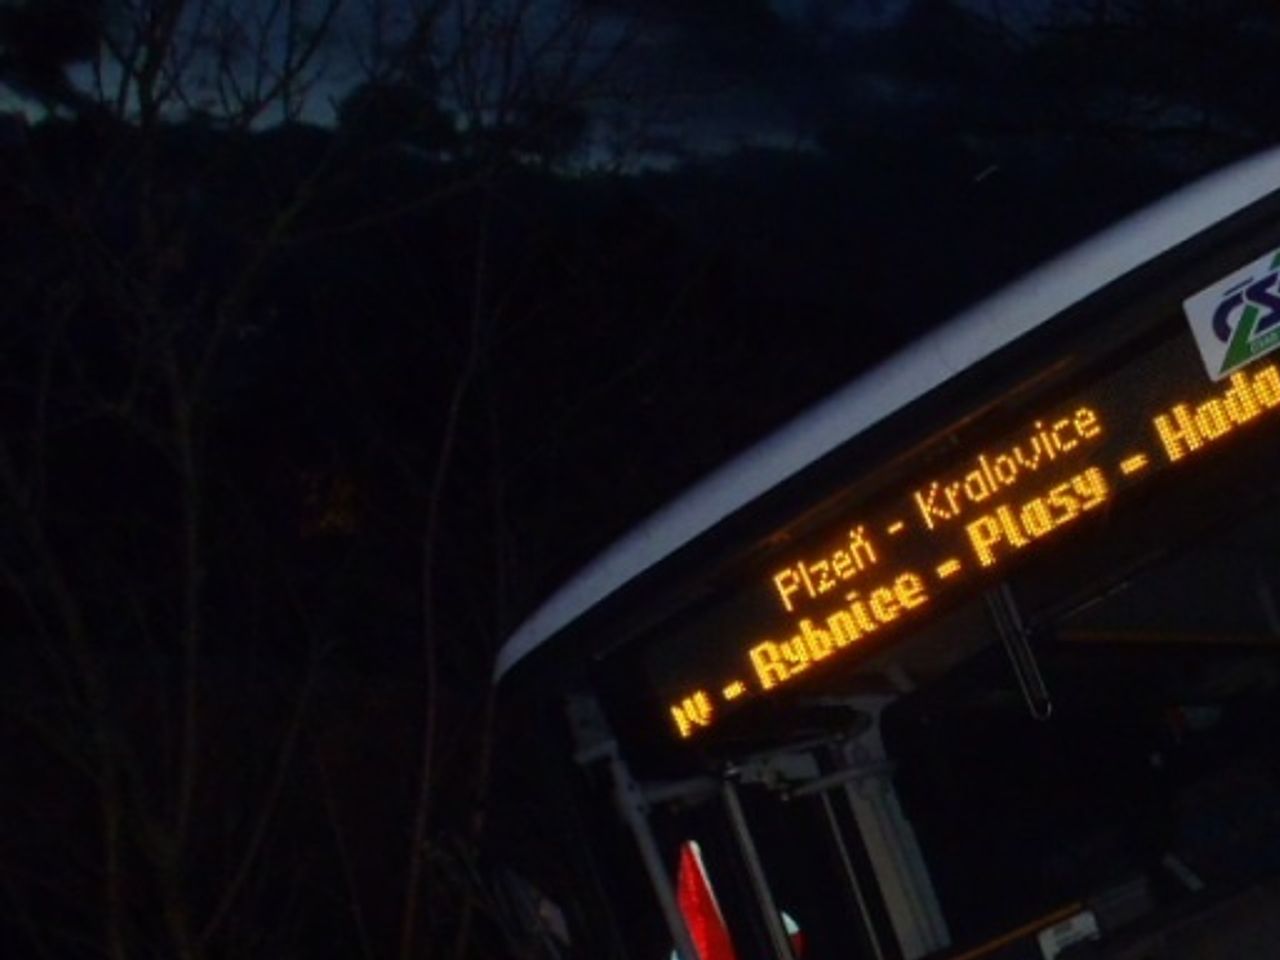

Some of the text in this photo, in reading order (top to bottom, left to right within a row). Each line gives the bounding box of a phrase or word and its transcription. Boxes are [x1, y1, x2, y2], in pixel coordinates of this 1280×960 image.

[722, 680, 747, 701] -
[748, 571, 929, 691] Rybnice
[935, 558, 962, 579] -
[964, 466, 1109, 568] Plasy
[1119, 453, 1148, 475] -
[773, 407, 1102, 612] Plzeň - Kralovice
